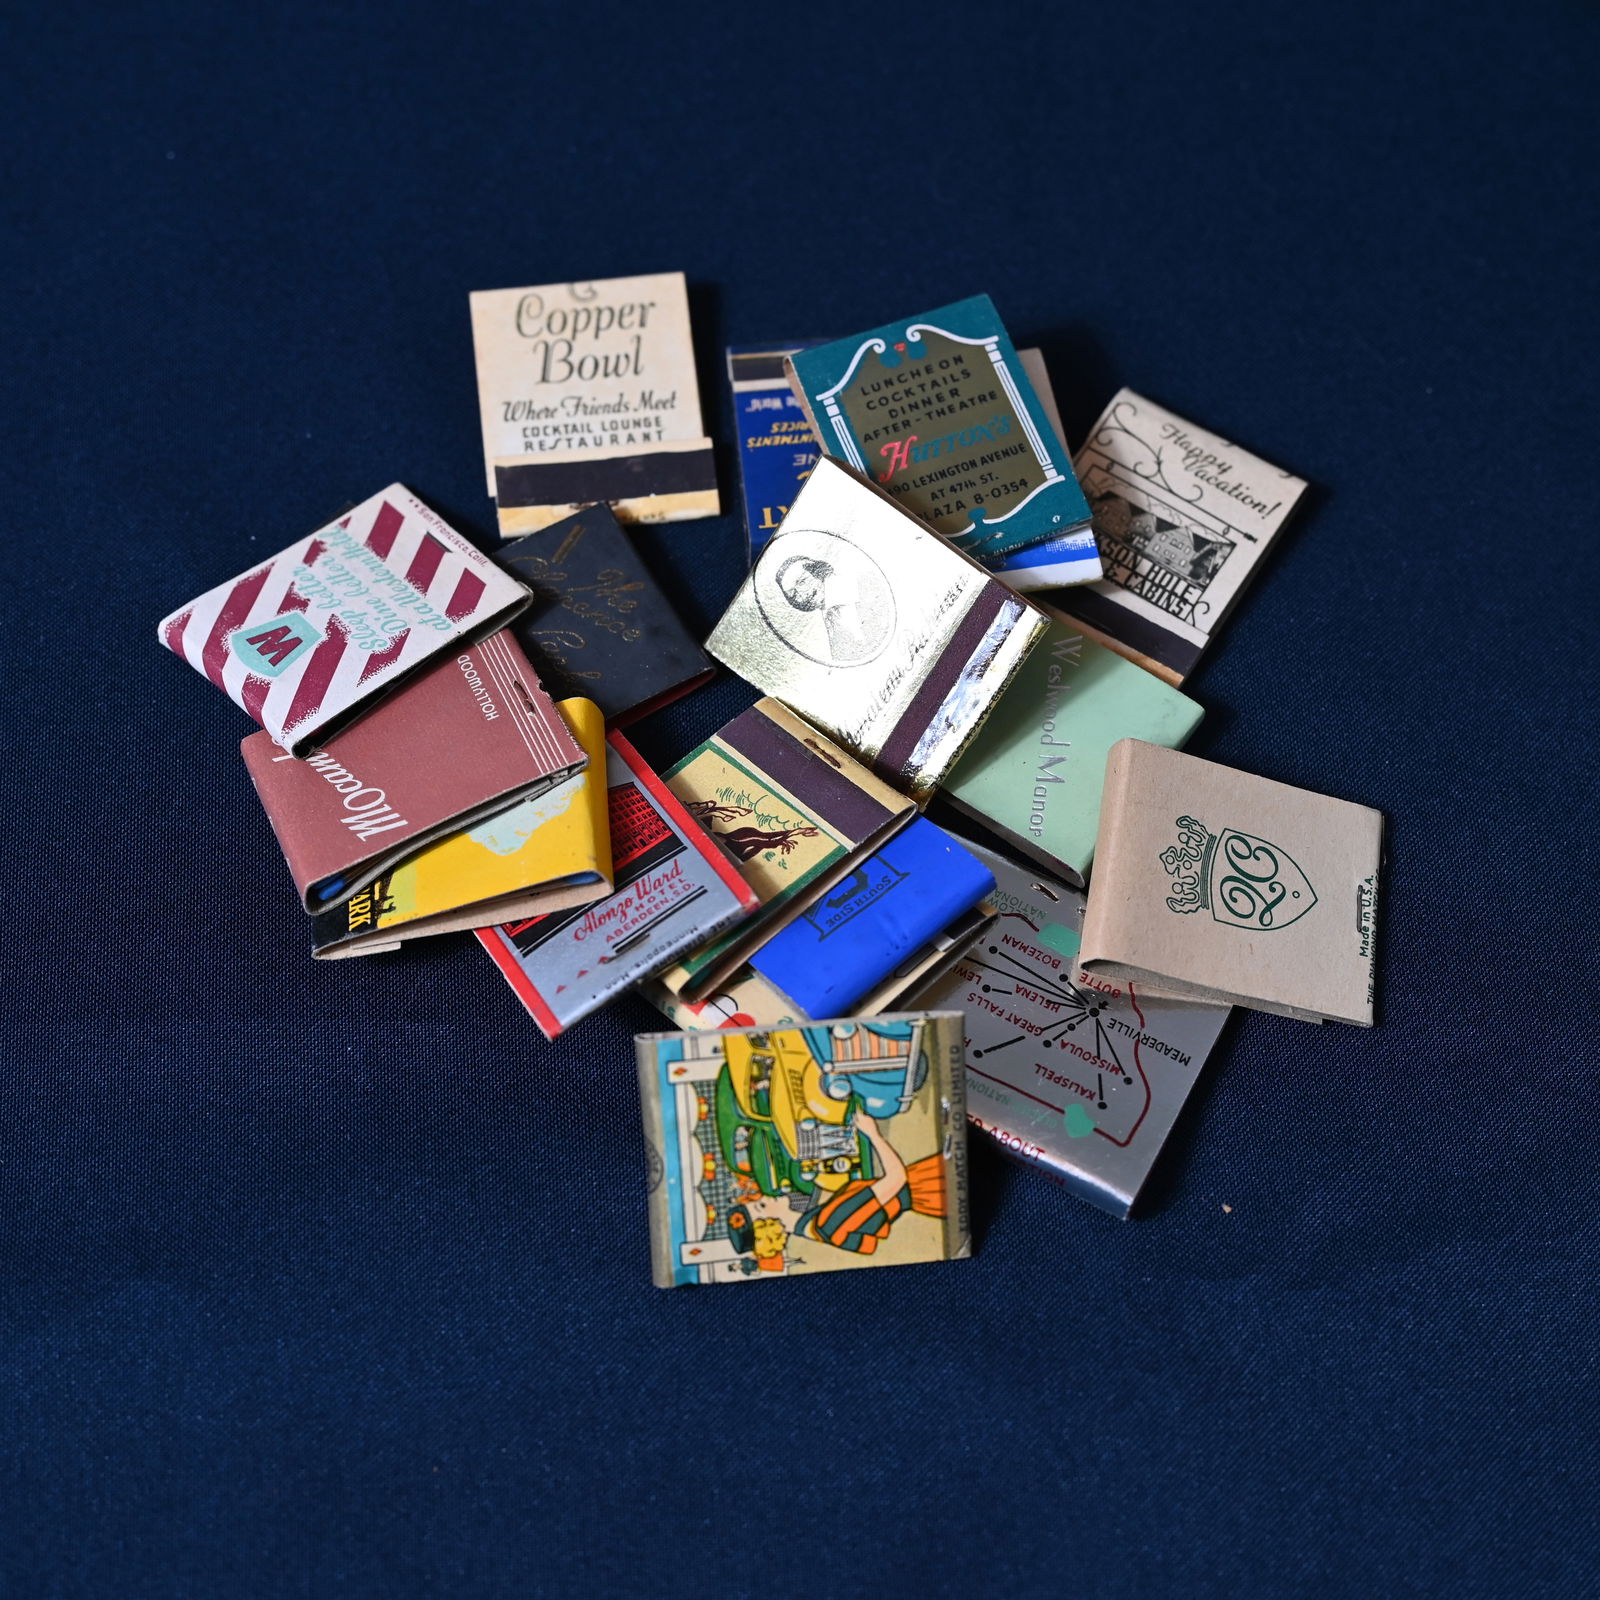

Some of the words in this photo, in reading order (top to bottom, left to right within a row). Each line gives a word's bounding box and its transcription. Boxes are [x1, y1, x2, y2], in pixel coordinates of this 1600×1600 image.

[516, 294, 655, 341] Copper
[533, 335, 645, 385] Bowl
[861, 355, 965, 396] LUNCHEON
[502, 401, 557, 423] Where
[561, 392, 630, 417] Friends
[634, 390, 677, 412] Meet
[866, 369, 972, 410] COCKTAILS
[889, 388, 960, 419] DINNER
[522, 424, 593, 438] COCKTAIL
[601, 416, 662, 432] LOUNGE
[525, 430, 664, 452] RESTAURANT
[912, 459, 978, 488] LEXINGTON
[981, 443, 1027, 466] AVENUE
[1161, 423, 1233, 475] Happy
[930, 489, 946, 502] AT
[950, 480, 977, 494] 47th
[980, 472, 999, 484] ST.
[1182, 452, 1282, 520] Vacation!
[320, 525, 366, 563] Hotel
[293, 566, 338, 610] better
[320, 554, 365, 600] better
[361, 551, 417, 606] Western
[1125, 570, 1190, 620] CABINS
[1149, 562, 1197, 600] HOLE
[340, 606, 388, 651] Sleep
[364, 594, 411, 637] Dine
[418, 611, 453, 634] at
[457, 654, 500, 722] HOLLYWOOD
[1040, 635, 1084, 747] Westwood
[1029, 754, 1068, 837] Manor
[348, 887, 374, 931] ARK
[573, 896, 633, 941] Alonzo
[631, 859, 683, 902] Ward
[634, 877, 688, 912] HOTEL
[855, 875, 892, 907] SOUTH
[1362, 874, 1375, 908] U.S.A.
[605, 895, 671, 943] ABERDEEN,
[671, 883, 696, 899] S.D.
[825, 904, 855, 927] SIDE
[1363, 911, 1371, 922] in
[1001, 934, 1062, 969] BOZEMAN
[1359, 924, 1371, 957] Made
[951, 966, 983, 986] LEWI
[1079, 972, 1123, 999] BUTTE
[967, 993, 1006, 1017] FALLS
[1015, 984, 1061, 1013] HELENA
[1003, 1008, 1043, 1037] GREAT
[1060, 1039, 1121, 1075] MISSOULA
[1107, 1018, 1193, 1067] MEADERVILLE
[1035, 1063, 1097, 1101] KALISPELL
[991, 1126, 1047, 1160] ABOUT
